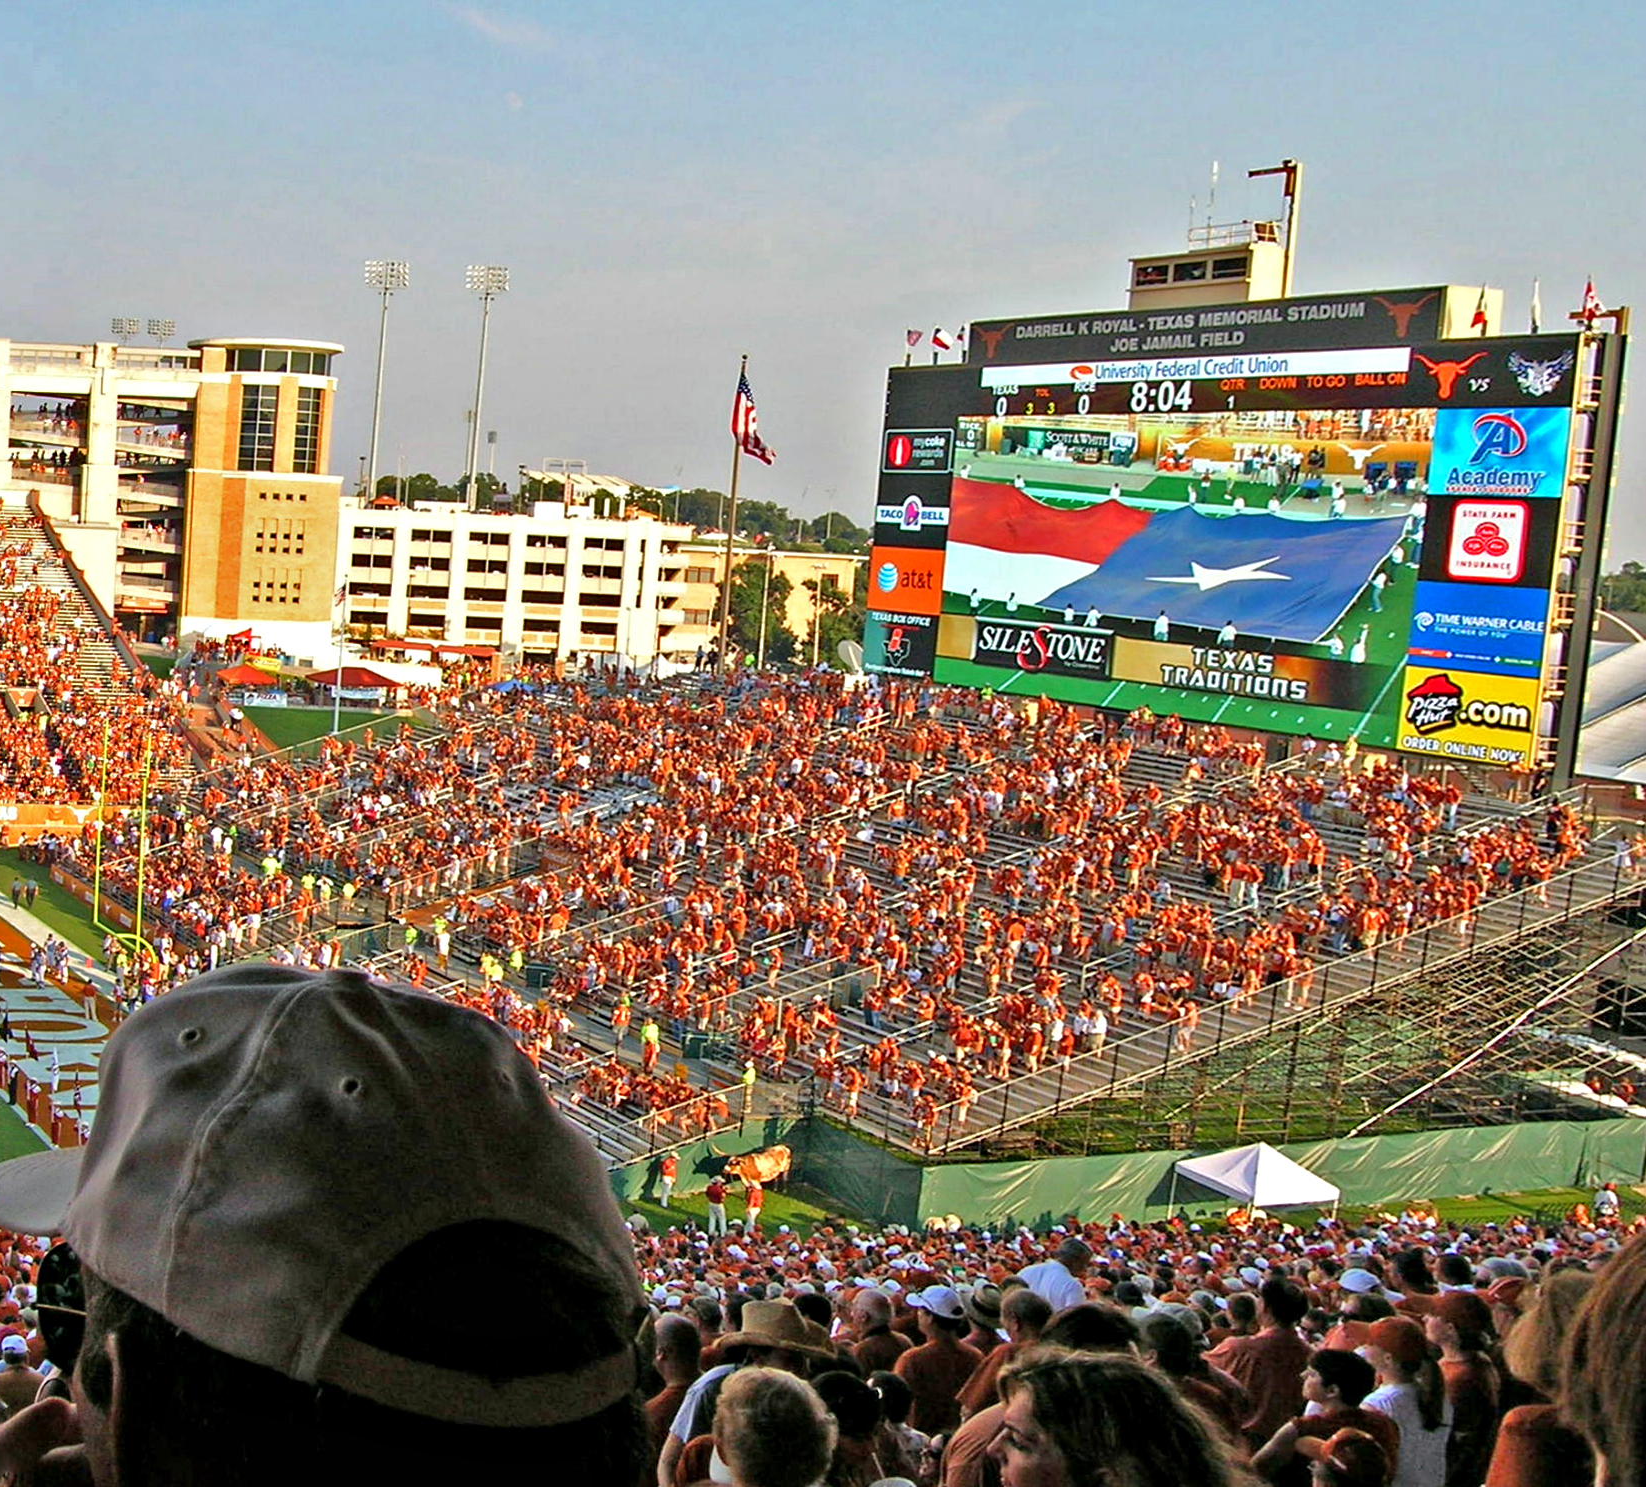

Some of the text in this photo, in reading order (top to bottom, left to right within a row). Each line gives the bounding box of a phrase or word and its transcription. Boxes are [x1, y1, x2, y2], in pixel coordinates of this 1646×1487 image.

[1015, 320, 1075, 340] DARRELL
[1078, 321, 1089, 336] K
[1092, 316, 1137, 334] ROYAL
[1147, 314, 1195, 331] TEXAS
[1198, 308, 1283, 328] MEMORIAL
[1287, 301, 1366, 322] STADIUM
[1110, 330, 1246, 353] JOE JAMAIL FIELD
[1094, 355, 1289, 381] University Federal Credit Union
[991, 384, 1019, 396] TEXAS
[1073, 382, 1096, 393] RICE
[1130, 380, 1193, 413] 8:04
[1220, 378, 1246, 391] QTR
[1259, 376, 1298, 390] DOWN
[1306, 375, 1323, 389] TO
[1325, 374, 1347, 388] GO
[1354, 373, 1385, 387] BALL
[1386, 371, 1407, 385] ON
[995, 394, 1236, 417] 0 3 3 0 1
[1446, 467, 1546, 492] Academy
[880, 508, 945, 521] TACO BELL
[1462, 509, 1517, 519] STATE FARM
[1456, 560, 1512, 570] INSURANCE
[900, 570, 934, 590] at&t
[1434, 612, 1545, 632] TIME WARNER CABLE
[979, 625, 1106, 672] SILESTONE
[1193, 647, 1274, 674] TEXAS
[1161, 664, 1308, 700] TRADITIONS
[1408, 693, 1459, 719] Pizza
[1415, 706, 1452, 726] Hut
[1458, 701, 1529, 728] .com
[1402, 736, 1441, 752] ORDER
[1444, 739, 1487, 759] ONLINE
